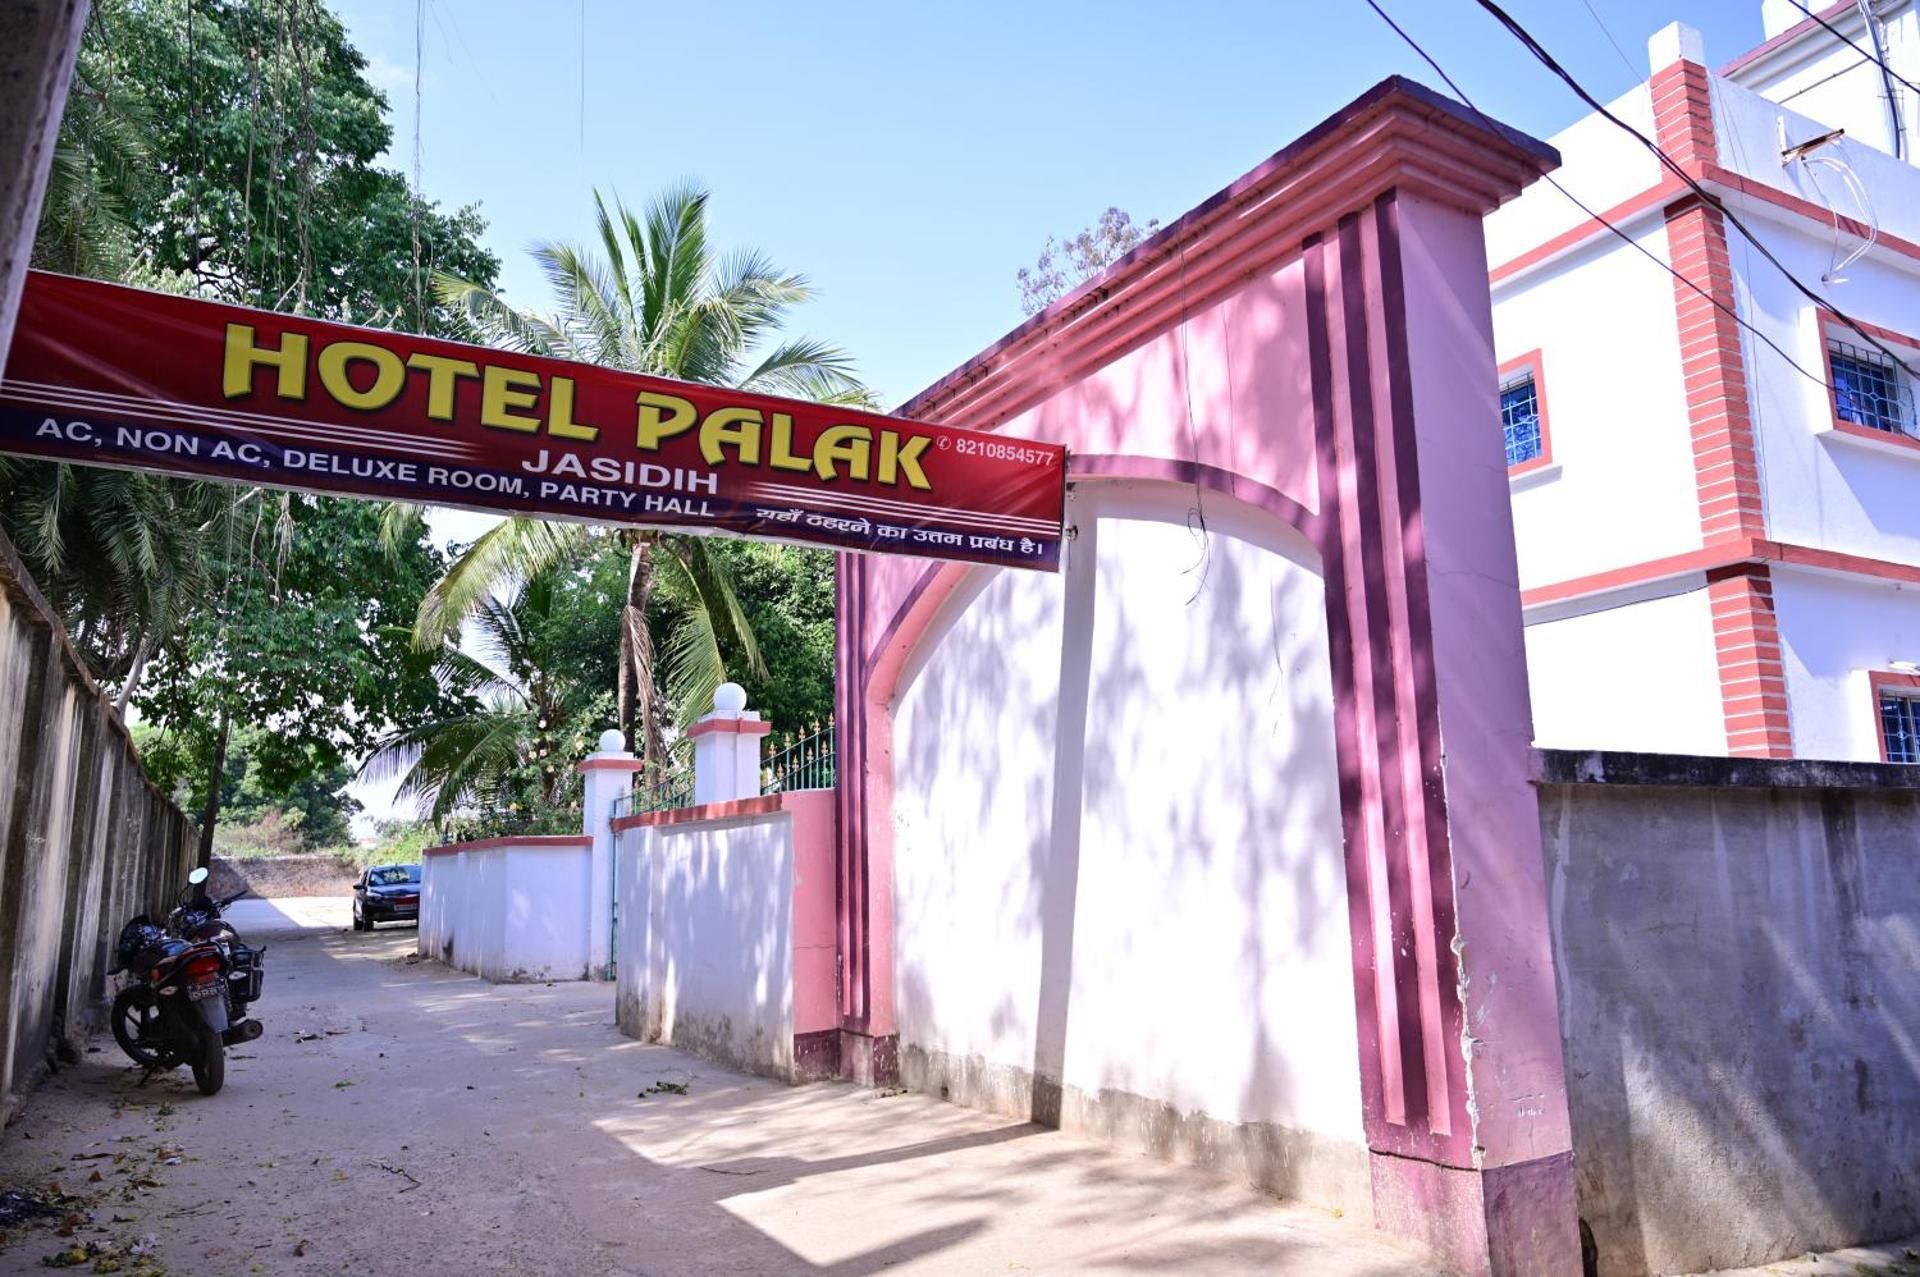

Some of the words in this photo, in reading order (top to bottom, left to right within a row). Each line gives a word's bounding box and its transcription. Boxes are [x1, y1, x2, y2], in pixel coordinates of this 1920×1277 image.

[223, 323, 599, 443] HOTEL
[636, 391, 933, 491] PALAK
[35, 417, 102, 447] AC,
[116, 426, 199, 456] NON
[211, 440, 270, 468] AC,
[283, 449, 417, 482] DELUXE
[428, 466, 529, 499] ROOM,
[540, 481, 639, 508] PARTY
[645, 494, 716, 517] HALL
[522, 449, 718, 495] JASIDIH
[956, 438, 1054, 466] 8210854577
[756, 507, 804, 523] यहाँ
[806, 516, 871, 535] ठहरने
[877, 524, 906, 540] का
[969, 535, 1014, 552] प्रबंध
